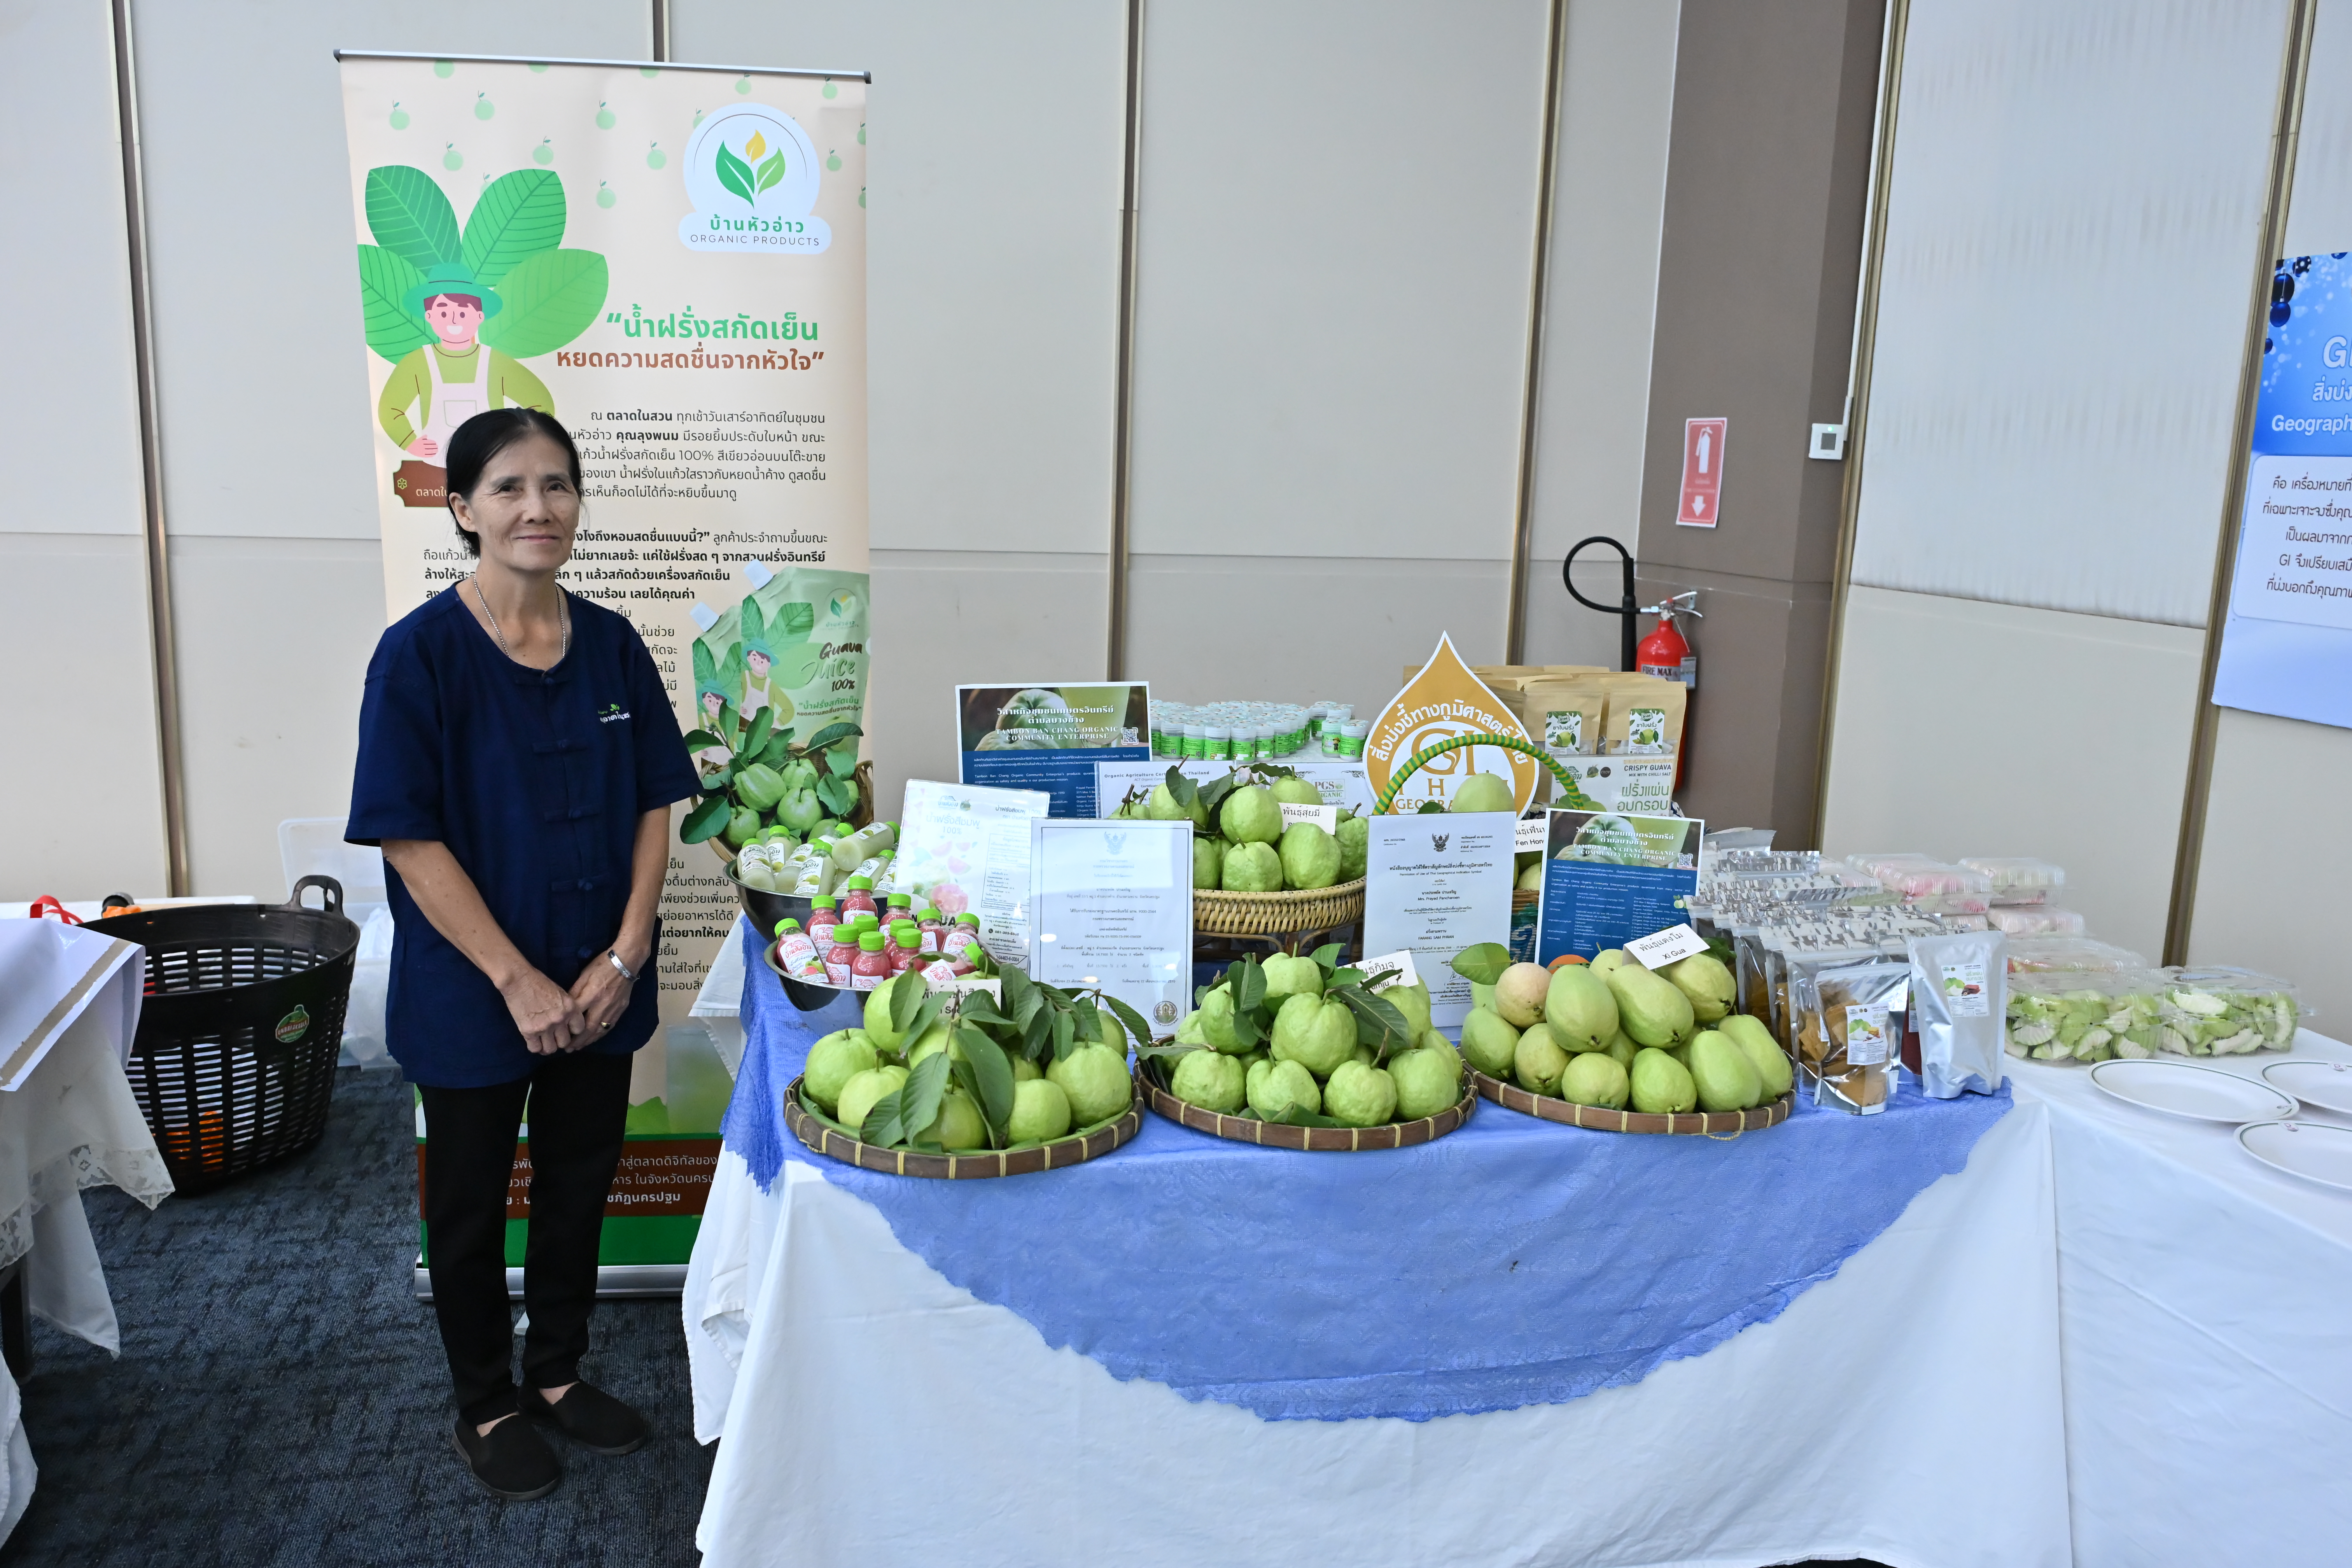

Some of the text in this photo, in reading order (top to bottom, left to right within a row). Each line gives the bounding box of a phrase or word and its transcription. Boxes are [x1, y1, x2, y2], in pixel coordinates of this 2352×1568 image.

[709, 214, 804, 233] บ้านหัวอ่าว
[690, 234, 820, 246] ORGANIC PRODUCTS
[557, 342, 824, 371] หยดความสดชื่นจากหัวใจ”
[591, 409, 825, 426] ณ ตลาดในสวน ทุกเช้าวันเสาร์อาทิตย์ในชุมชน
[617, 430, 679, 443] คุณลุงพนม
[683, 428, 797, 442] มีรอยยิ้มประดับใบหน้า
[802, 434, 825, 443] ขณะ
[679, 450, 714, 461] 100%
[718, 449, 825, 462] สีเขียวอ่อนบนโต๊ะขาย
[620, 464, 785, 481] น้ำฝรั่งในแก้วใสราวกับหยดน้ำค้าง
[789, 469, 826, 483] ดูสดชื่น
[2273, 475, 2287, 489] คือ
[714, 529, 828, 545] ลูกค้าประจำถามขึ้นขณะ
[643, 549, 707, 561] แค่ใช้ฝรั่งสด
[712, 553, 719, 564] ๆ
[723, 550, 825, 563] จากสวนฝรั่งอินทรีย์
[2280, 554, 2291, 566] GI
[574, 571, 582, 582] ๆ
[586, 568, 730, 581] แล้วสกัดด้วยเครื่องสกัดเย็น
[630, 589, 695, 602] เลยได้คุณค่า
[1642, 666, 1672, 676] FIRE MAX
[831, 679, 856, 692] 100%
[1315, 781, 1334, 790] PGS
[1621, 779, 1669, 797] ฝรั่งแผ่น
[1617, 800, 1668, 812] อบกรอบ
[943, 826, 962, 835] 100%
[1573, 844, 1602, 852] TAMBON
[1639, 931, 1684, 952] พันธุ์แตงโม
[1671, 947, 1686, 957] Gua
[618, 1155, 717, 1170] าสู่ตลาดดิจิทัลของ
